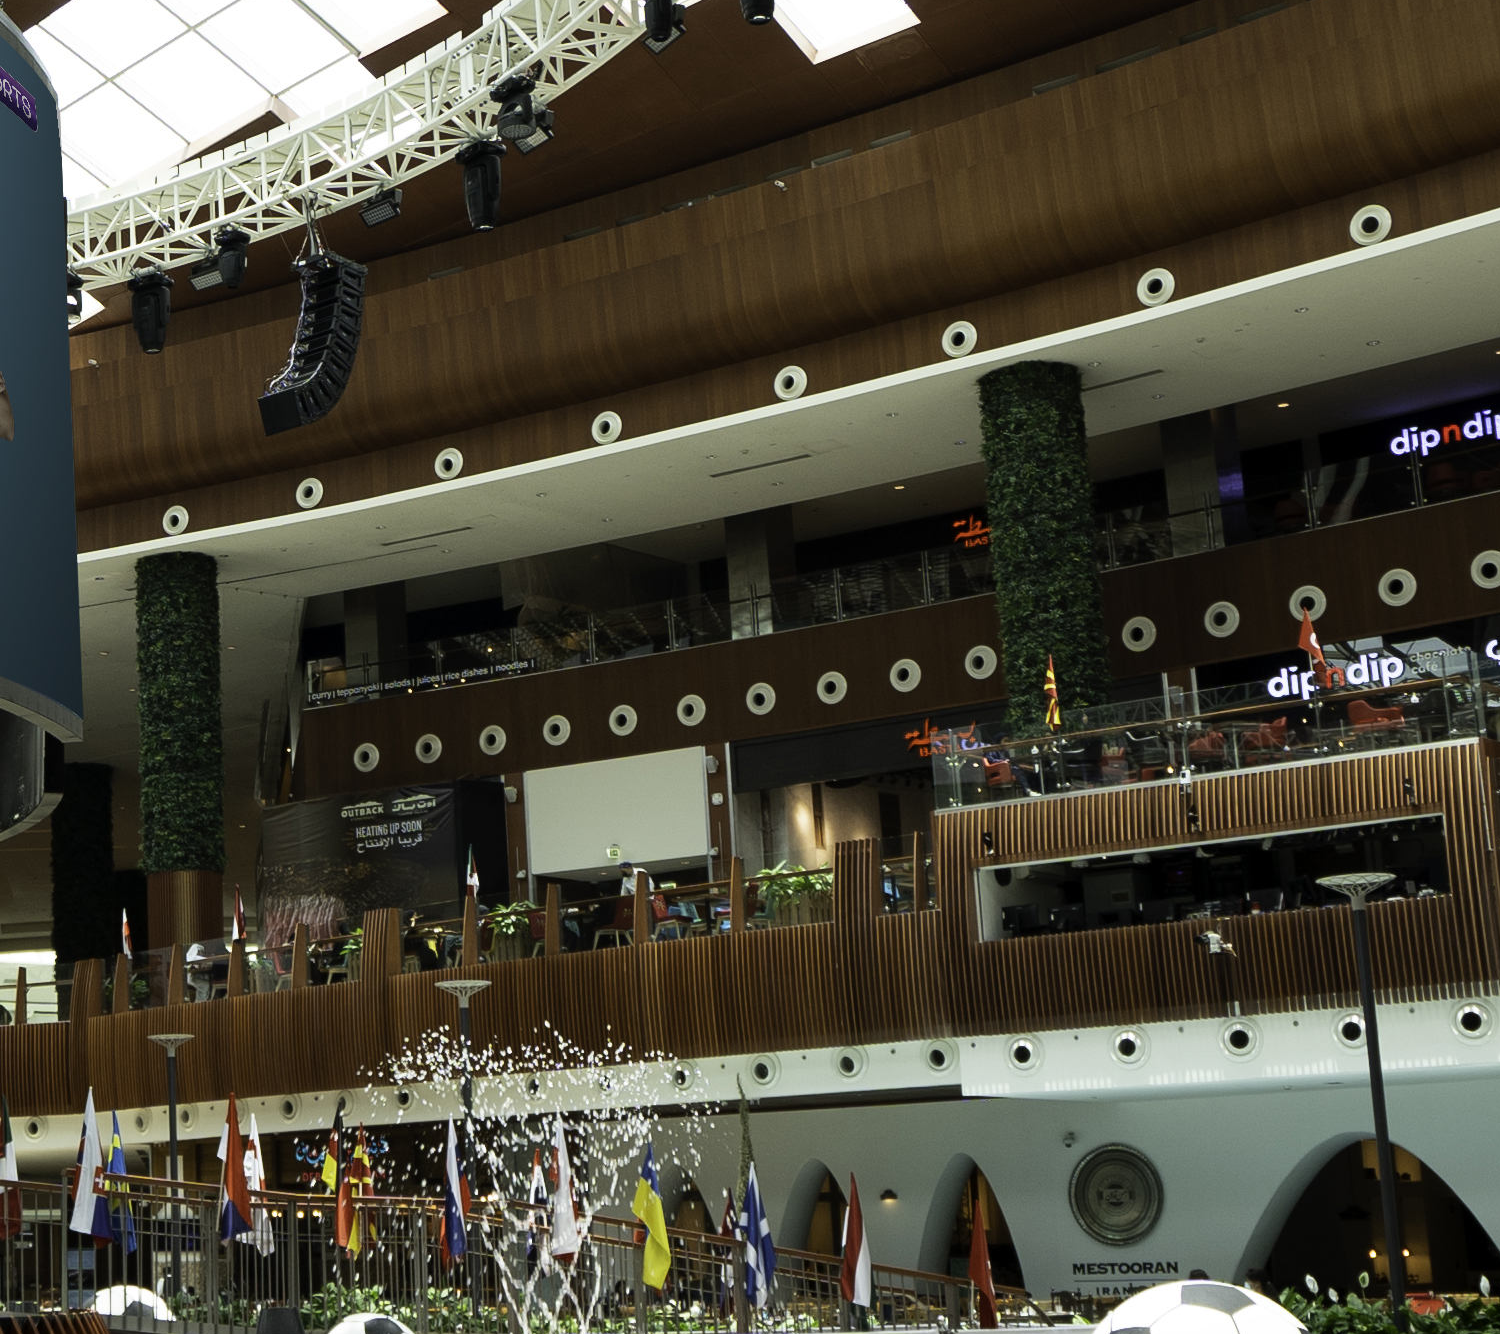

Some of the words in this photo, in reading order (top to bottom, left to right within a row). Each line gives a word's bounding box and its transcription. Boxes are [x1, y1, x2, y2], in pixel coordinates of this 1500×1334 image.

[311, 690, 333, 701] curry
[444, 671, 461, 681] rice
[461, 667, 488, 679] dishes
[495, 659, 529, 672] noodles
[341, 806, 384, 818] OUTBACK
[355, 824, 388, 839] HEATING
[389, 823, 400, 835] UP
[401, 820, 423, 834] SOON
[1072, 1261, 1179, 1276] MESTOORAN
